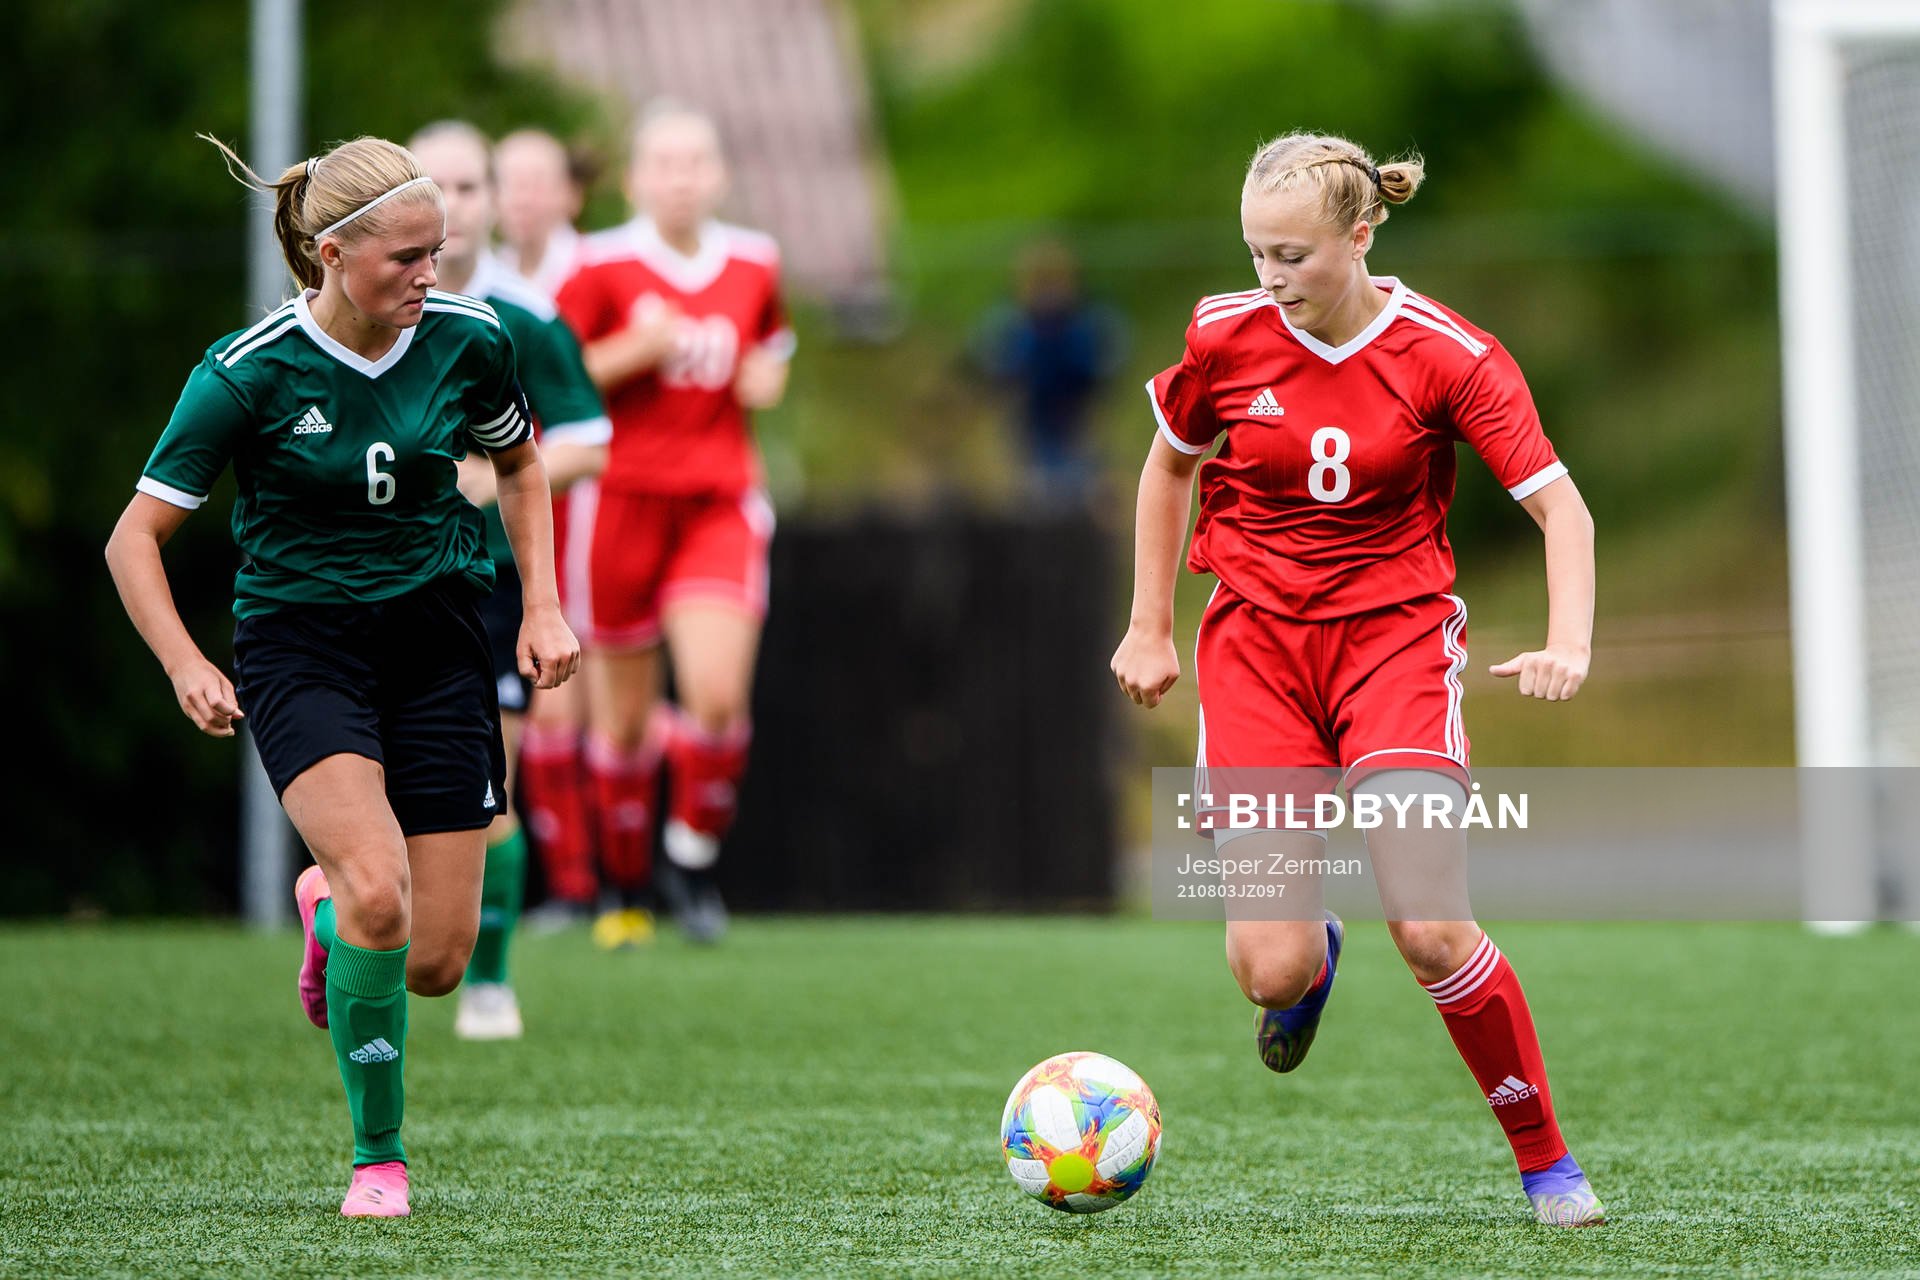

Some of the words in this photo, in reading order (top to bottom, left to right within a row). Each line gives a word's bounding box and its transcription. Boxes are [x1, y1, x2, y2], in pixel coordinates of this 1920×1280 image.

[1247, 404, 1285, 416] adidas
[293, 423, 333, 435] adidas
[366, 442, 396, 505] 6
[1308, 426, 1351, 503] 8
[349, 1049, 399, 1064] adidas
[1487, 1083, 1539, 1106] adidas
